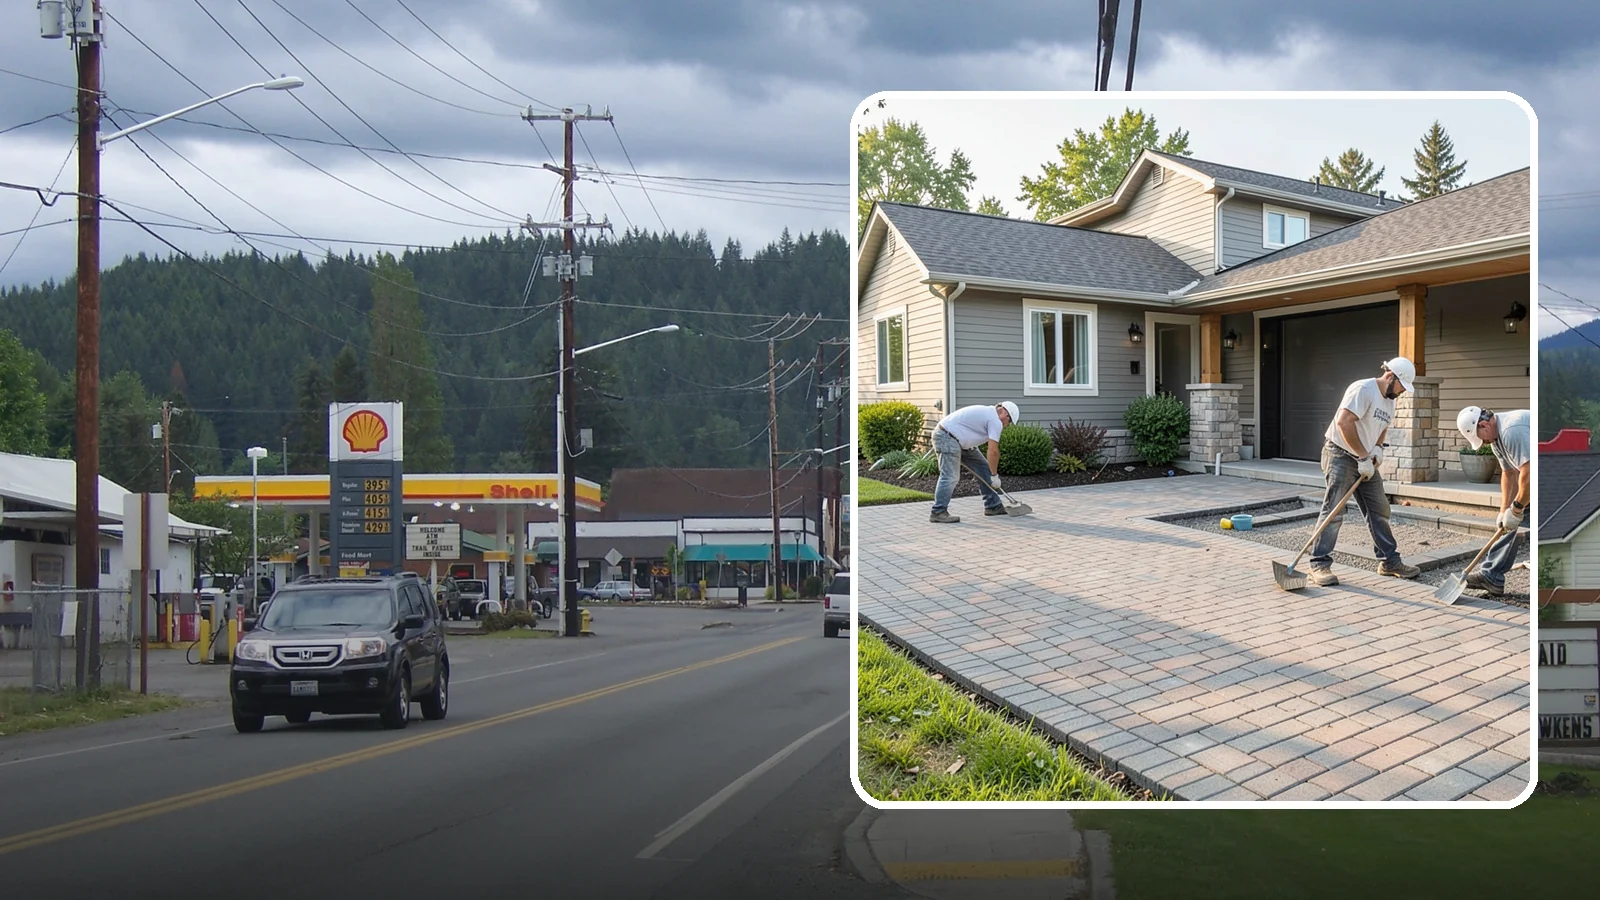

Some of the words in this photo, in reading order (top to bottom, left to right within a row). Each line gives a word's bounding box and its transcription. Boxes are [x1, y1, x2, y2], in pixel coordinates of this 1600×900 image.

[366, 480, 383, 490] 395
[490, 484, 547, 499] Shell
[366, 494, 383, 504] 405
[366, 508, 383, 518] 415
[366, 522, 383, 533] 429
